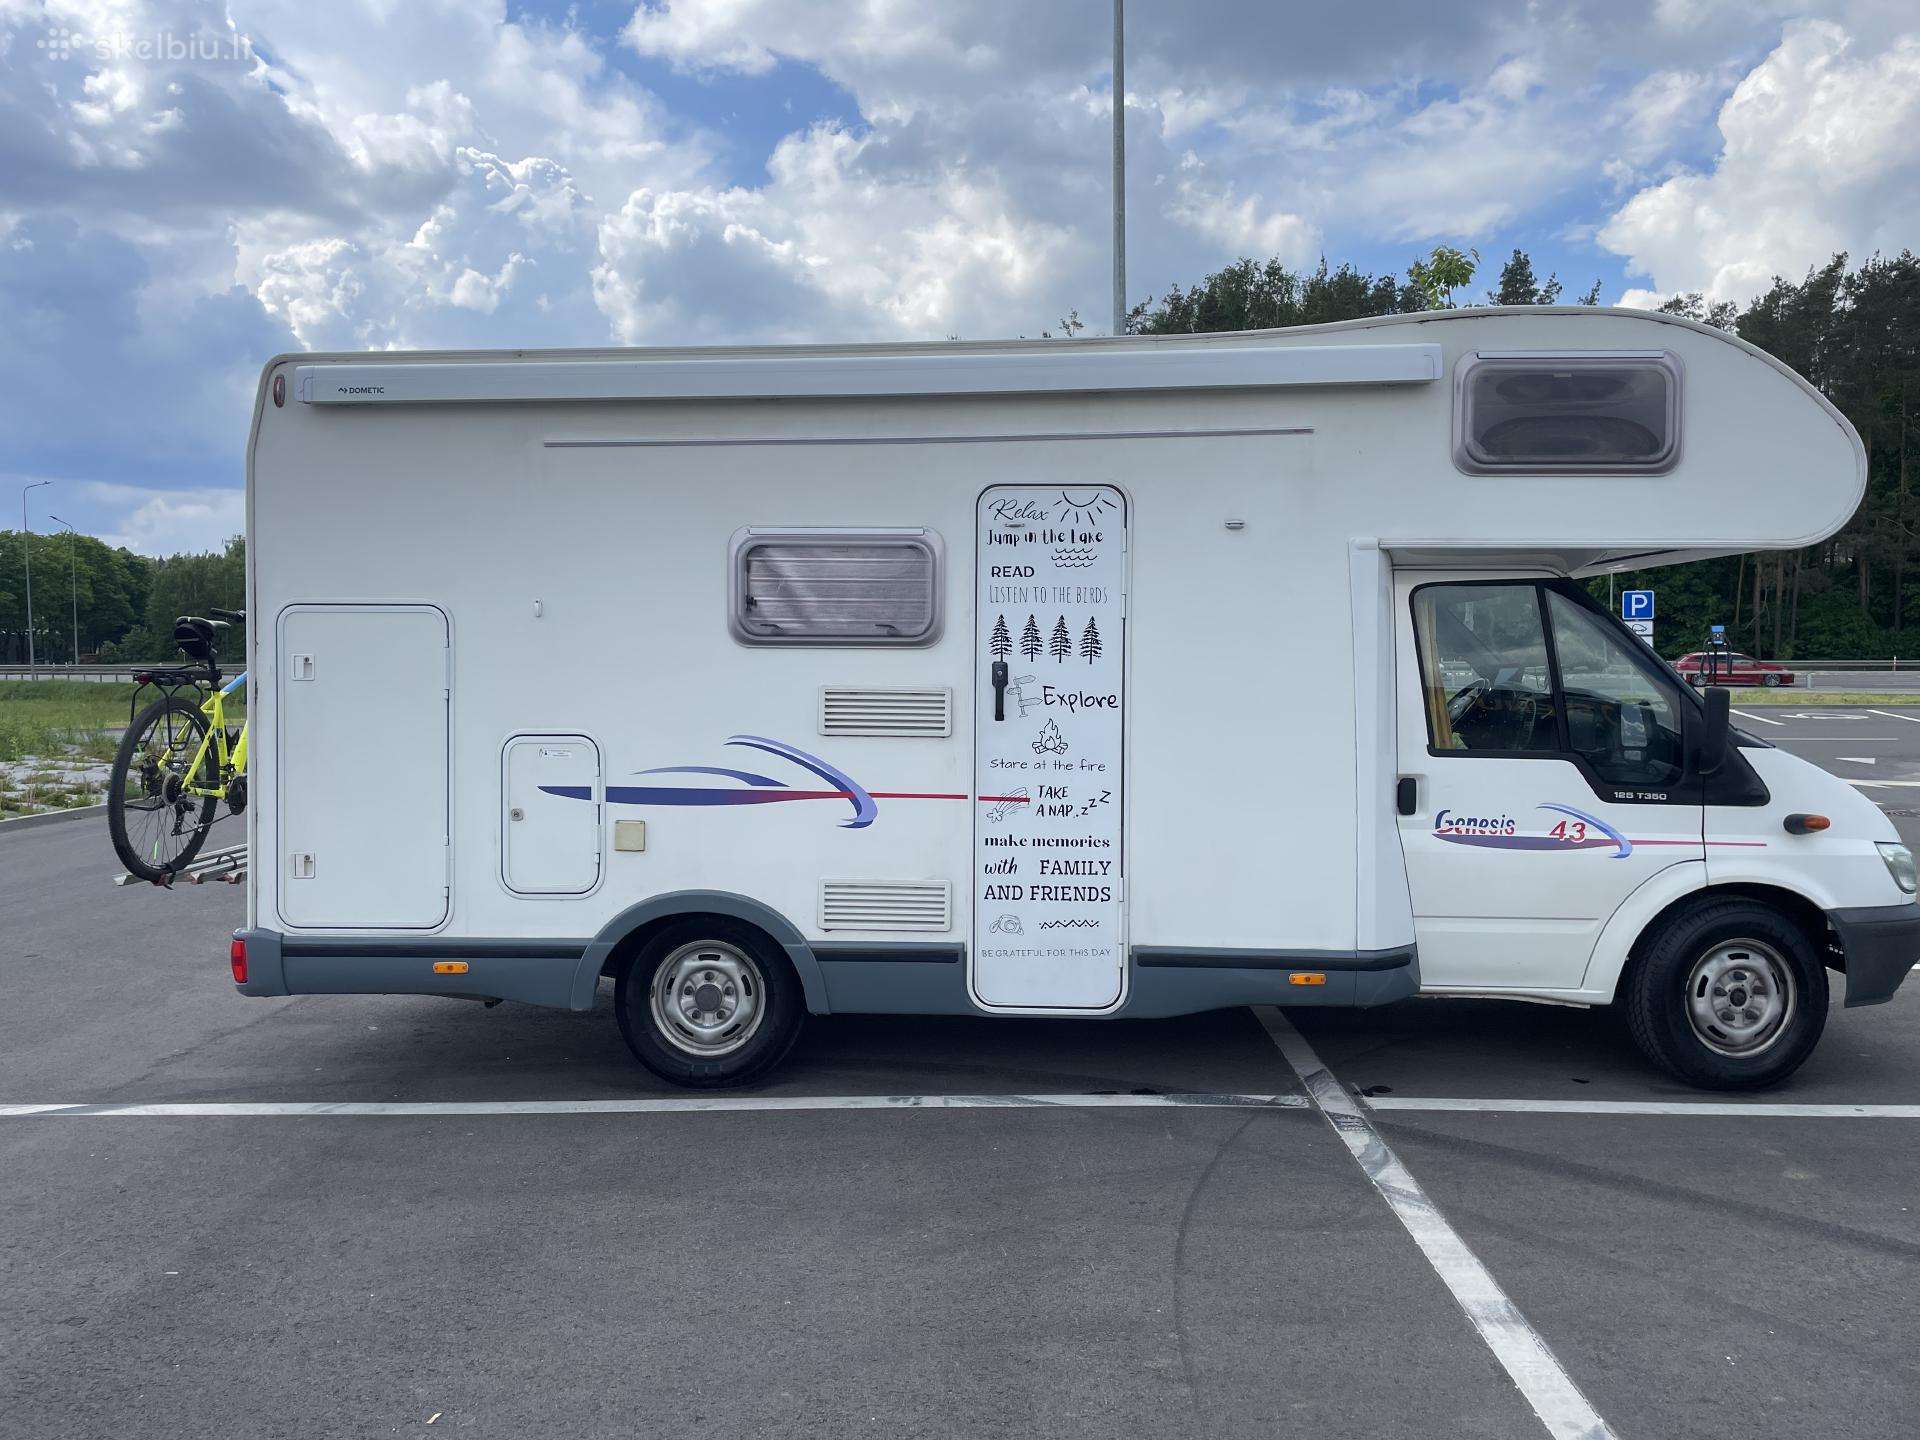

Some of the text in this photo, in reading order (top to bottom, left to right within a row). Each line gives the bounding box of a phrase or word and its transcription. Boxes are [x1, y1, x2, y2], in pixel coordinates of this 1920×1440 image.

[988, 499, 1050, 520] Relax
[987, 530, 1020, 547] Jump
[1024, 531, 1037, 543] in
[1043, 529, 1066, 545] the
[991, 566, 1034, 577] READ
[1033, 587, 1047, 604] TO
[1053, 587, 1072, 603] THE
[1631, 594, 1648, 616] P
[1042, 685, 1119, 713] Explore
[1033, 760, 1046, 770] at
[1052, 760, 1074, 771] the
[1079, 758, 1106, 772] fire
[1038, 785, 1068, 799] TAKE
[1614, 791, 1667, 800] 125 T350
[1036, 804, 1045, 817] A
[1435, 810, 1586, 843] Genesis 43
[984, 834, 1110, 848] make memories
[984, 857, 1111, 876] with FAMILY
[984, 885, 1111, 902] AND FRIENDS
[981, 948, 1111, 958] BE GRATEFUL FOR THIS DAY
